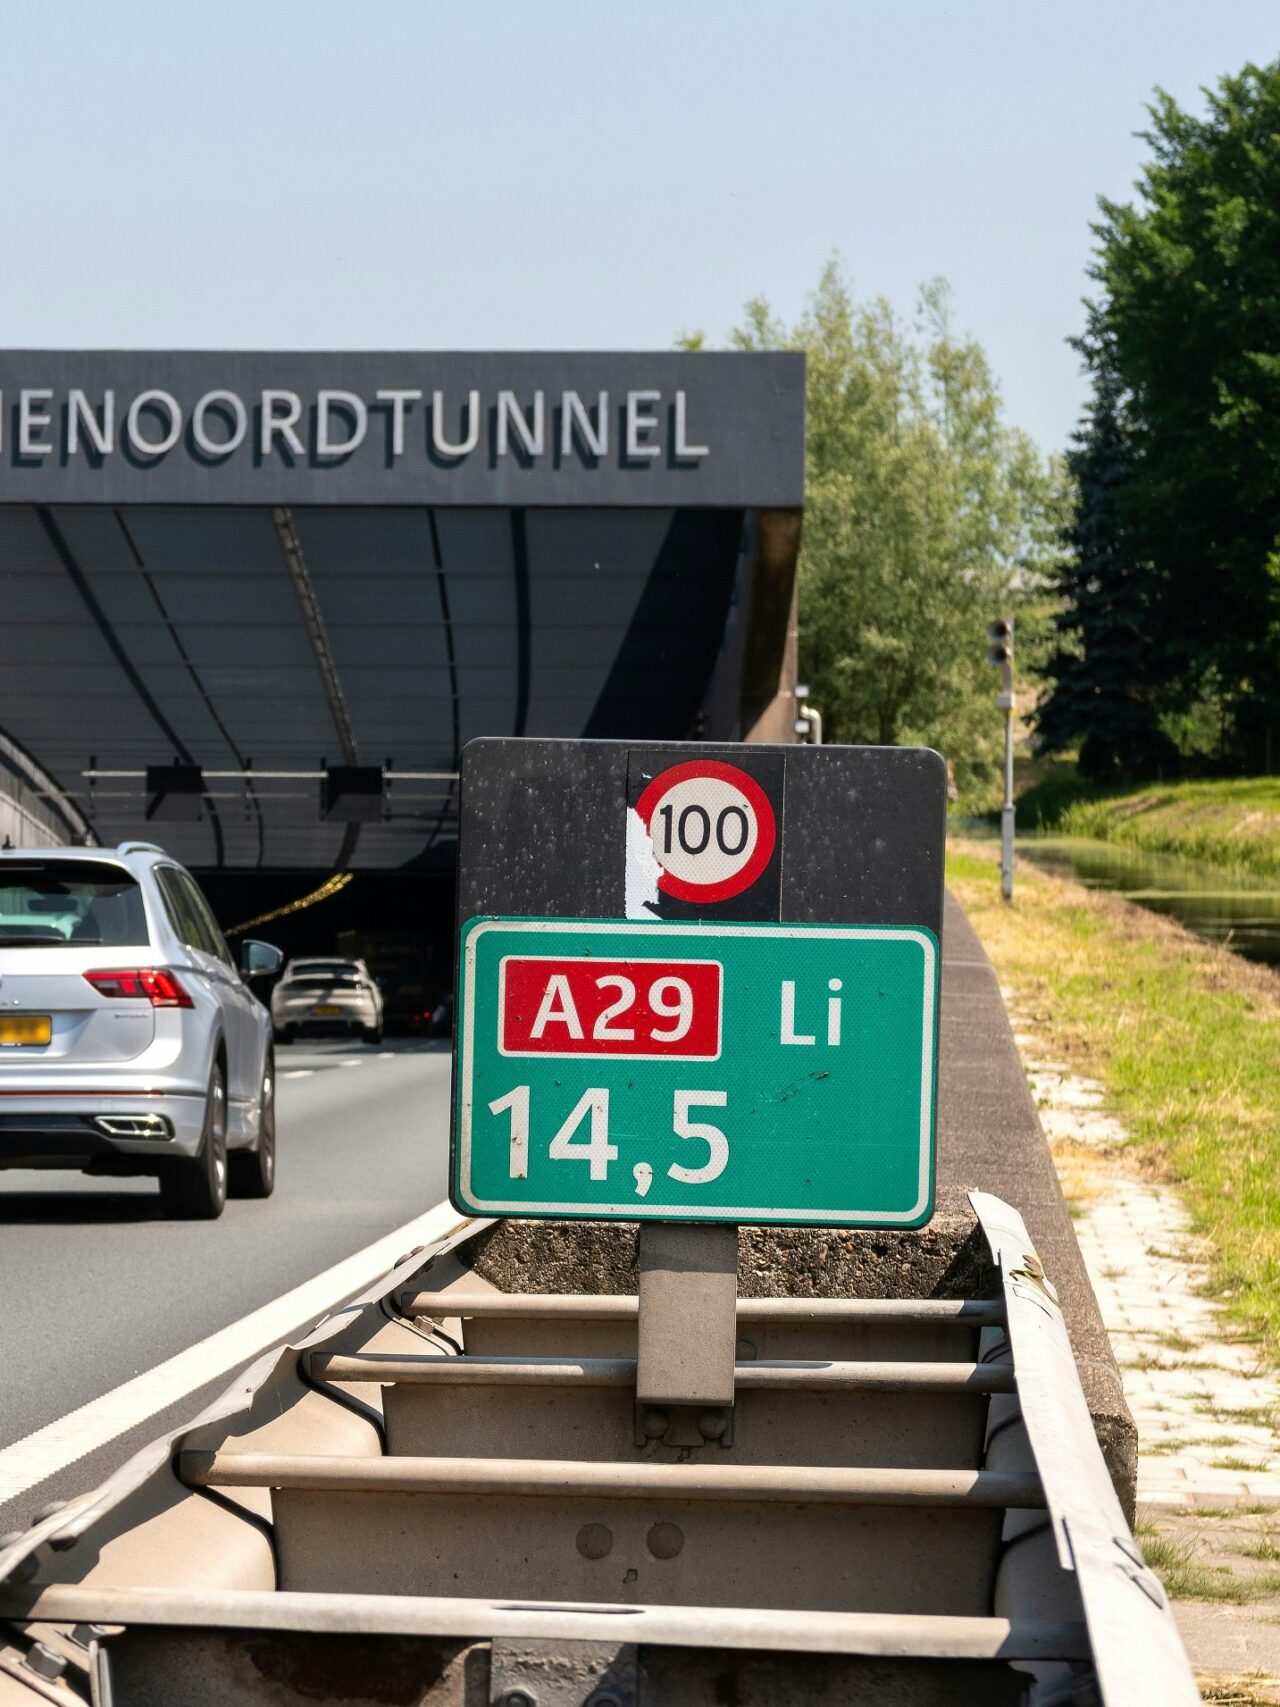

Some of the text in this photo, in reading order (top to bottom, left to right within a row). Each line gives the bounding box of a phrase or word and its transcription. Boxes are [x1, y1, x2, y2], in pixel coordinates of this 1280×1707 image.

[658, 803, 750, 857] 100
[528, 973, 844, 1047] A29 Li
[487, 1084, 731, 1198] 14,5
